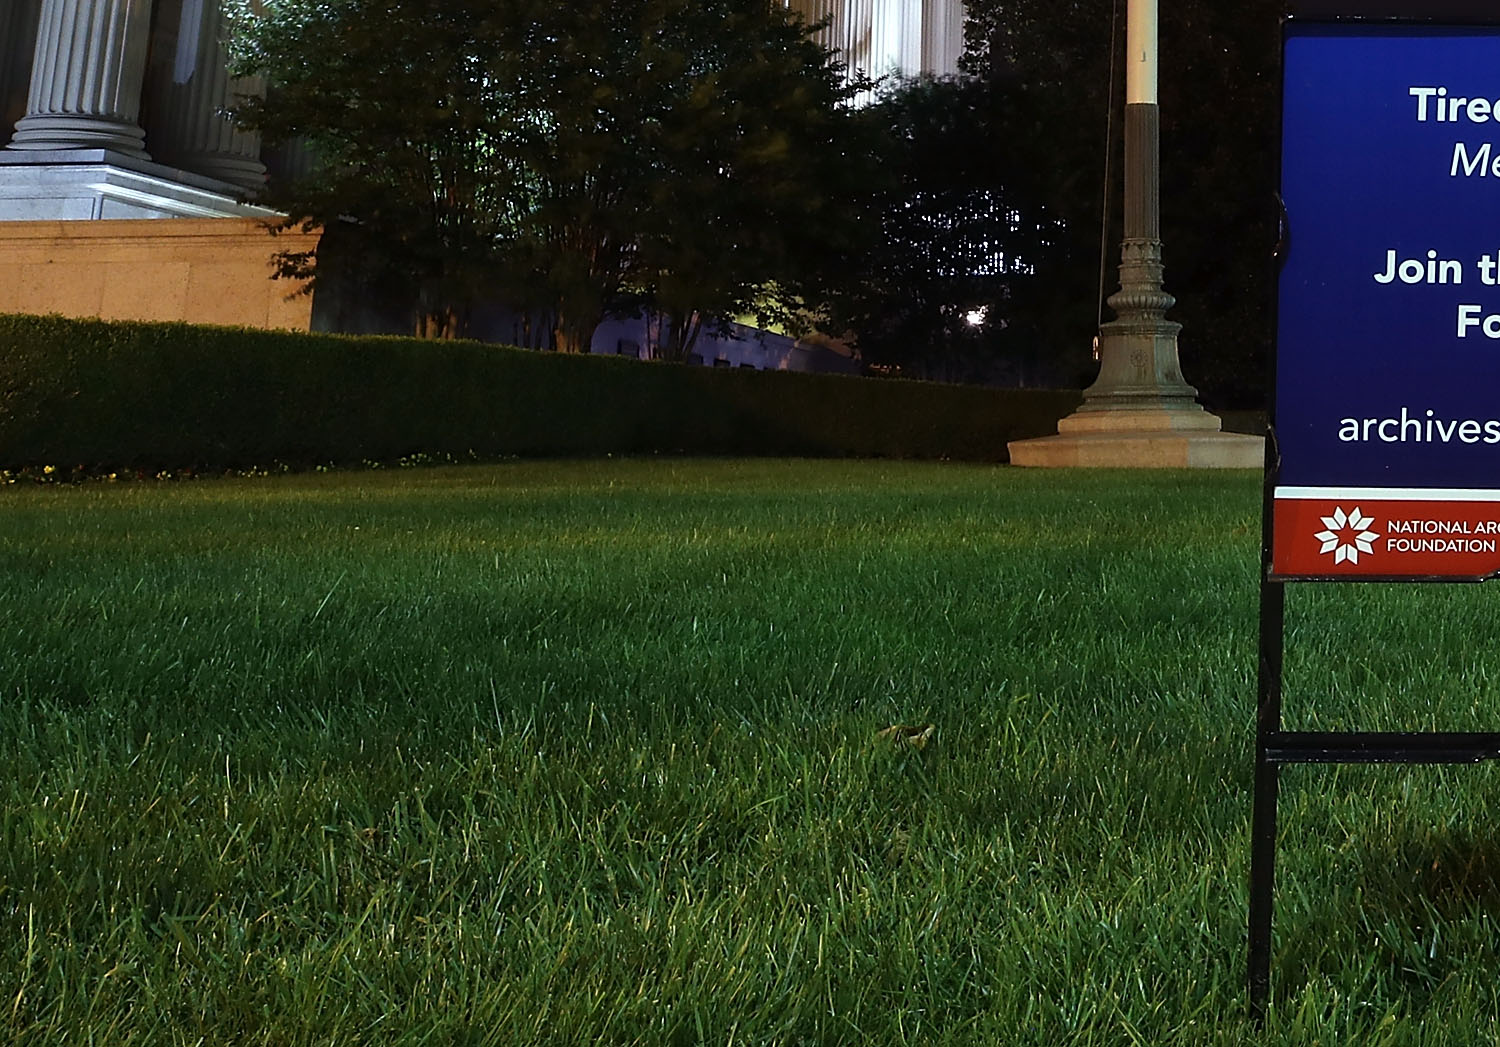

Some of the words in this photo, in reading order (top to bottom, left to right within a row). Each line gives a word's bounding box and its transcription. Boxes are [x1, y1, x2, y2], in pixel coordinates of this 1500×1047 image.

[1374, 250, 1462, 284] Join
[1387, 520, 1472, 534] NATIONAL
[1387, 538, 1496, 553] FOUNDATION
